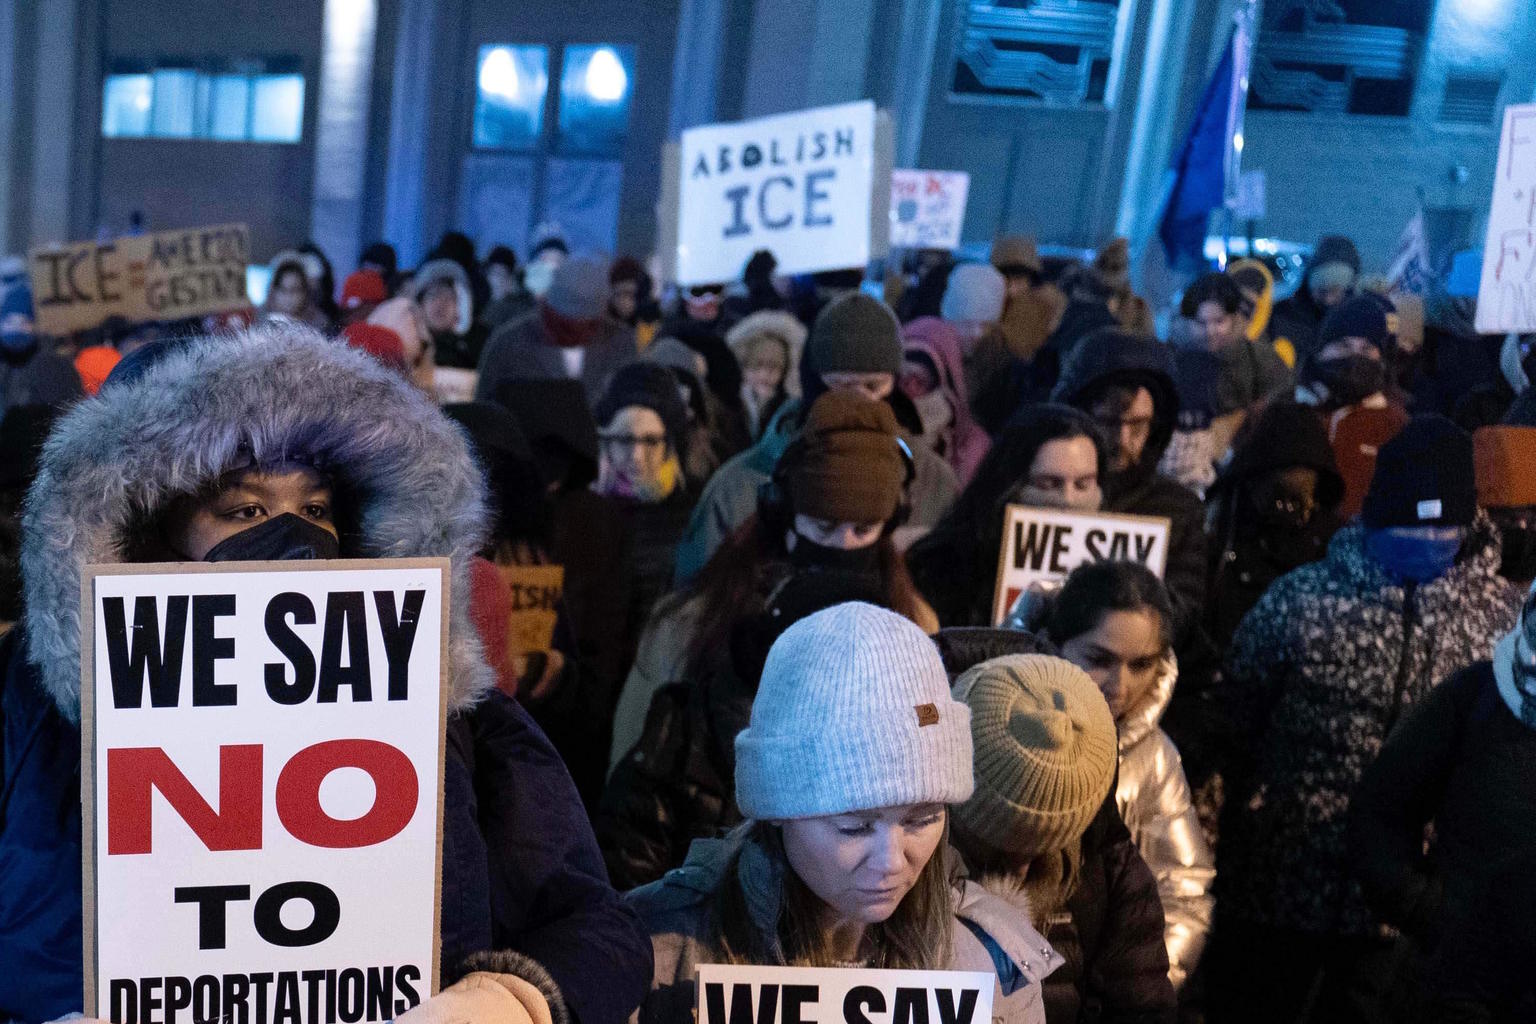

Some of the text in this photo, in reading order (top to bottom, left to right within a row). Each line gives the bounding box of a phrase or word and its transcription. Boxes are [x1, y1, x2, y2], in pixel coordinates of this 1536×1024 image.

[693, 128, 854, 178] ABOLISH
[722, 169, 836, 238] ICE
[35, 245, 120, 306] ICE
[1015, 522, 1072, 574] WE
[102, 589, 426, 709] WE SAY
[107, 738, 419, 855] NO
[174, 881, 341, 950] TO
